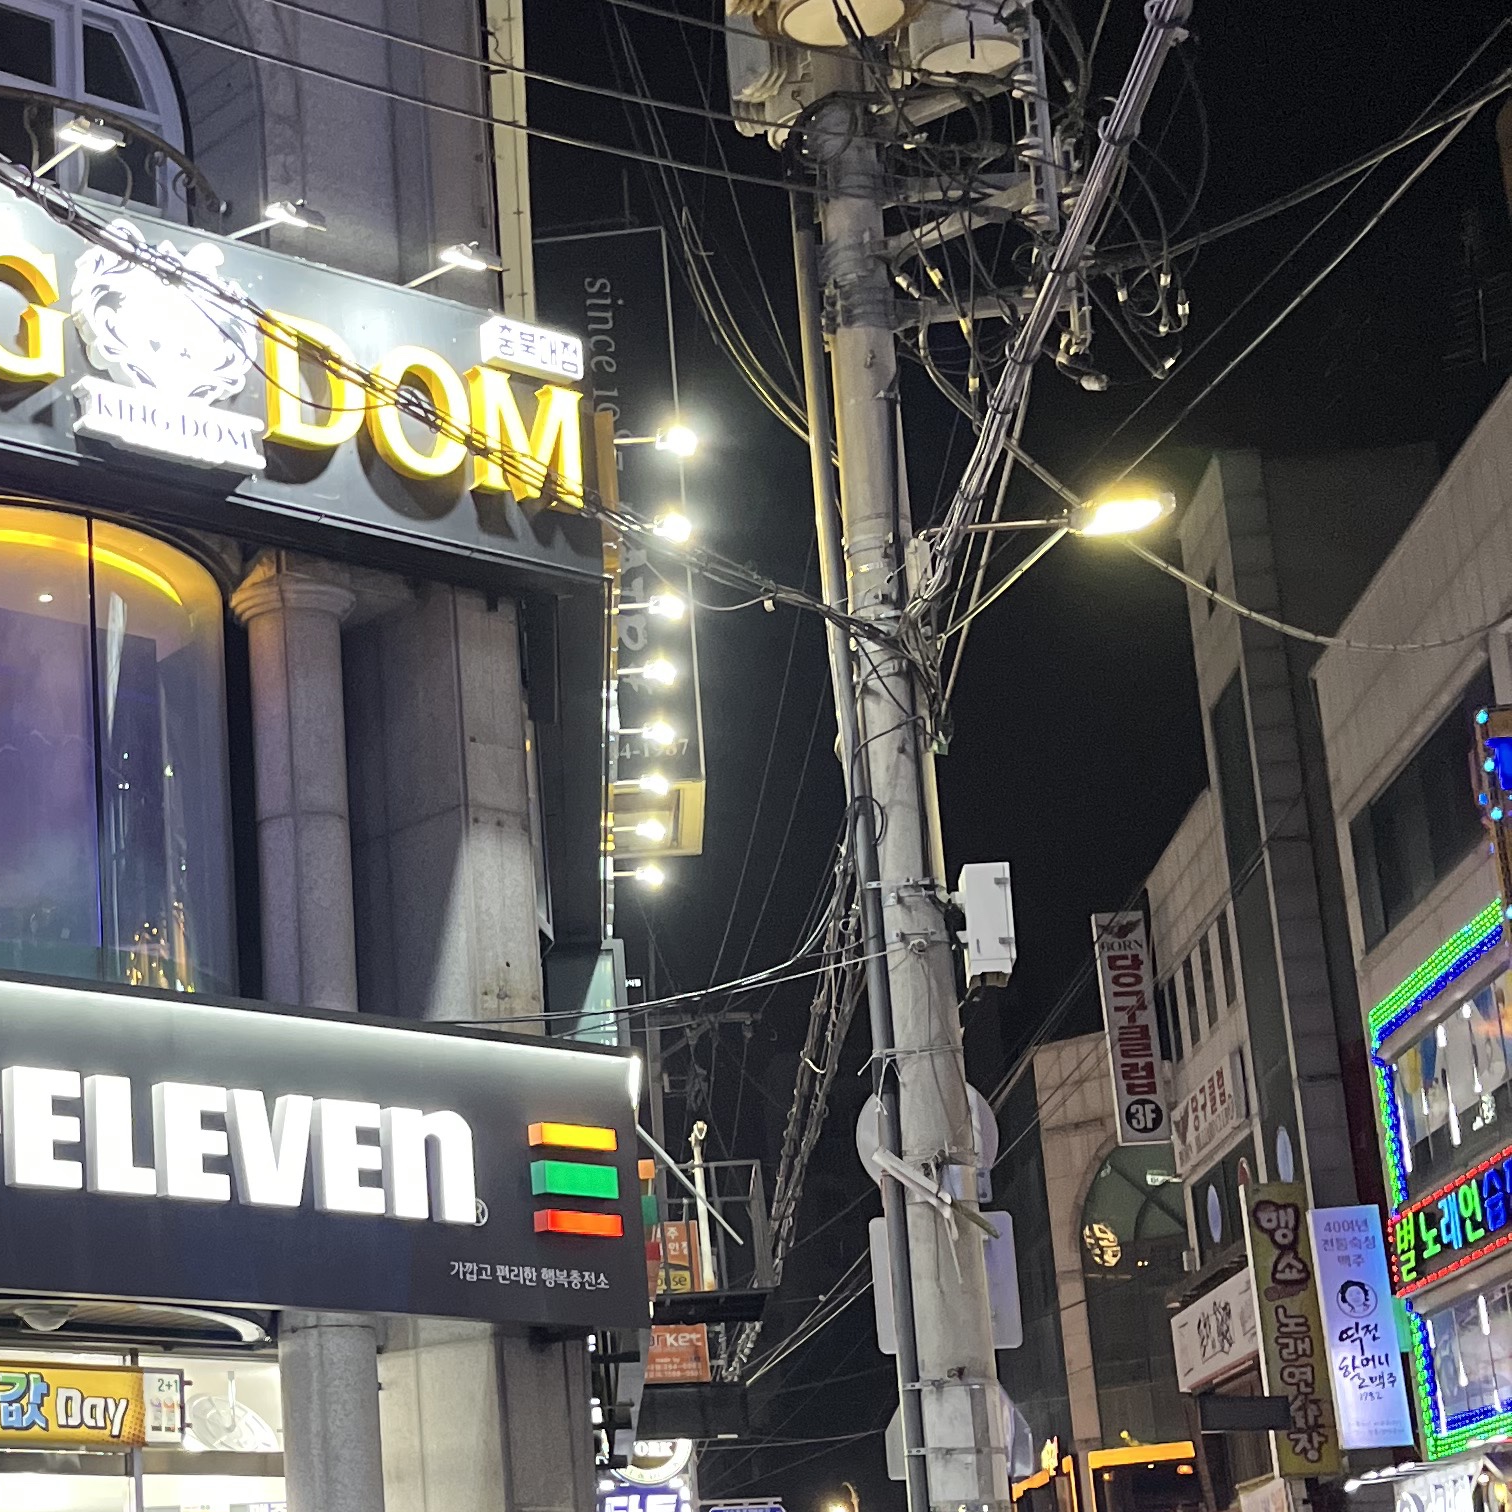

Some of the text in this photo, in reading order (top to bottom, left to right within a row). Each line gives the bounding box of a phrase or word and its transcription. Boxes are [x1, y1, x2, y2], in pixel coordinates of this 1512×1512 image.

[261, 305, 585, 512] DOM
[1106, 953, 1158, 1096] 당구클럽
[1130, 1103, 1157, 1129] 3F
[450, 1261, 610, 1290] 가깝고 편리한 행복충전소
[56, 1386, 129, 1438] Day
